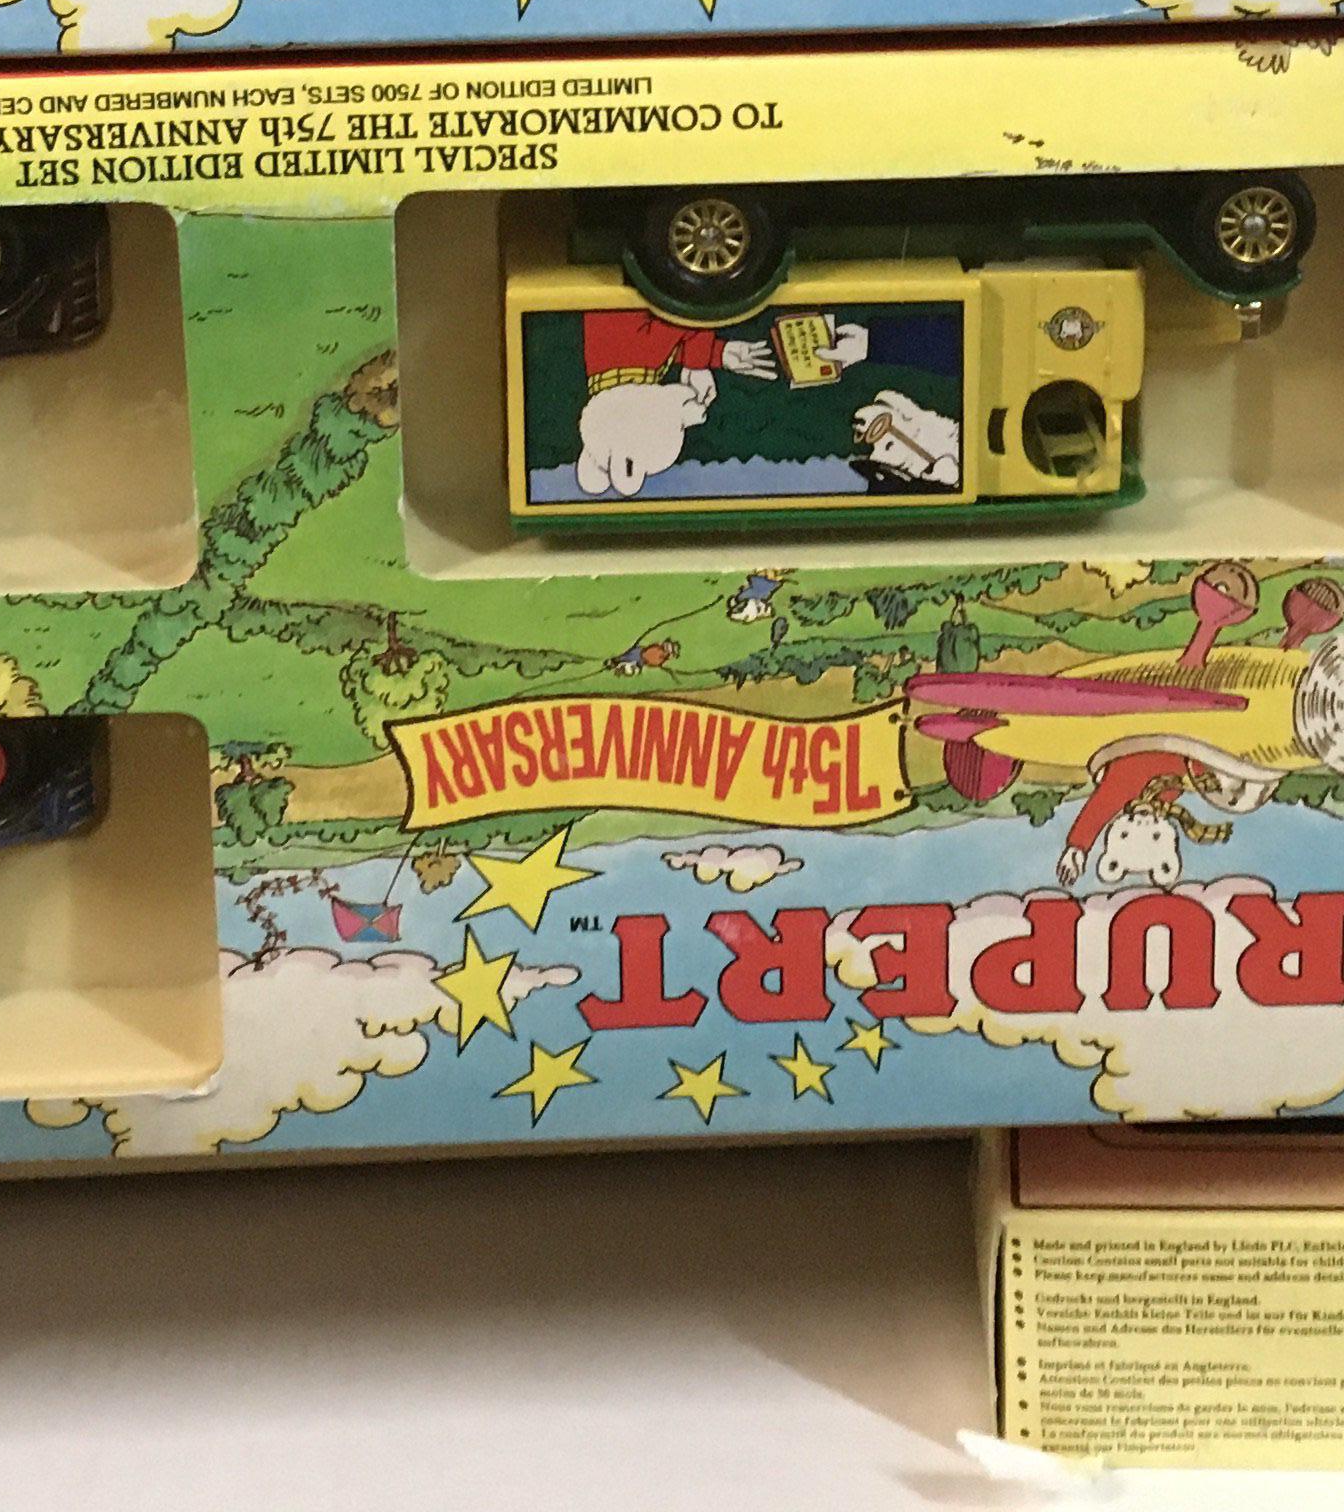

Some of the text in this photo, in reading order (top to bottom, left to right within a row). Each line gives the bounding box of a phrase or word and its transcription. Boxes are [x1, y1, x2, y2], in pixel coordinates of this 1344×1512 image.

[232, 87, 295, 107] EACH
[301, 84, 365, 105] SETS,
[371, 83, 422, 102] 7500
[428, 81, 460, 101] OF
[465, 79, 556, 99] EDITION
[562, 76, 652, 97] LIMITED
[38, 94, 88, 114] AND
[94, 90, 226, 112] NUMBERED
[347, 112, 418, 141] THE
[429, 104, 721, 138] COMMEMORATE
[732, 102, 783, 130] TO
[259, 112, 335, 147] 75th
[15, 143, 557, 188] SPECIAL LIMITED EDITION SET
[419, 703, 881, 815] 75th ANNIVERSARY
